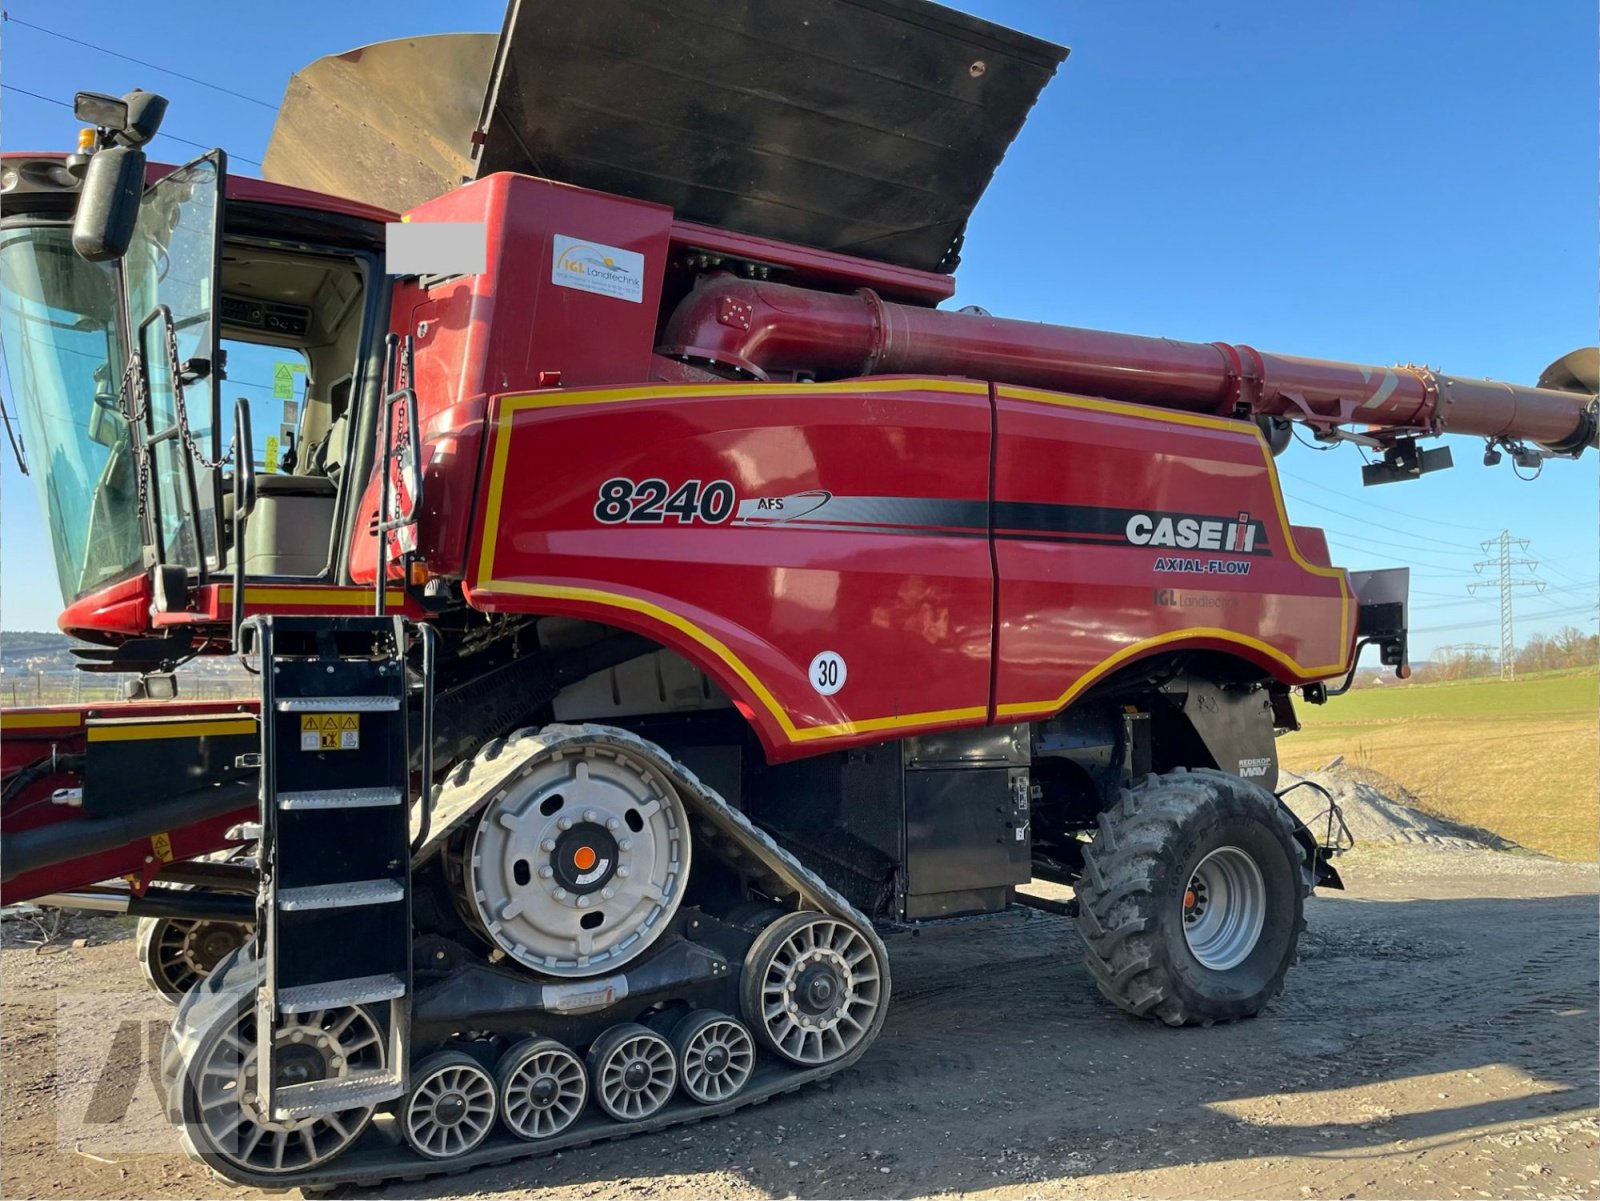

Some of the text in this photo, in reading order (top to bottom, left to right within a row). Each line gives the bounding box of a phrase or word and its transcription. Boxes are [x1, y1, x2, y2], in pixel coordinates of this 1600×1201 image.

[564, 259, 585, 274] IGL
[587, 267, 640, 287] Landtechnik
[593, 477, 736, 525] 8240
[757, 498, 784, 511] AFS
[1153, 557, 1251, 575] AXIAL-FLOW
[1153, 589, 1239, 609] IGL Landtechnik
[818, 660, 838, 686] 30
[1239, 758, 1271, 767] REDEKOP
[1240, 766, 1267, 778] MAV
